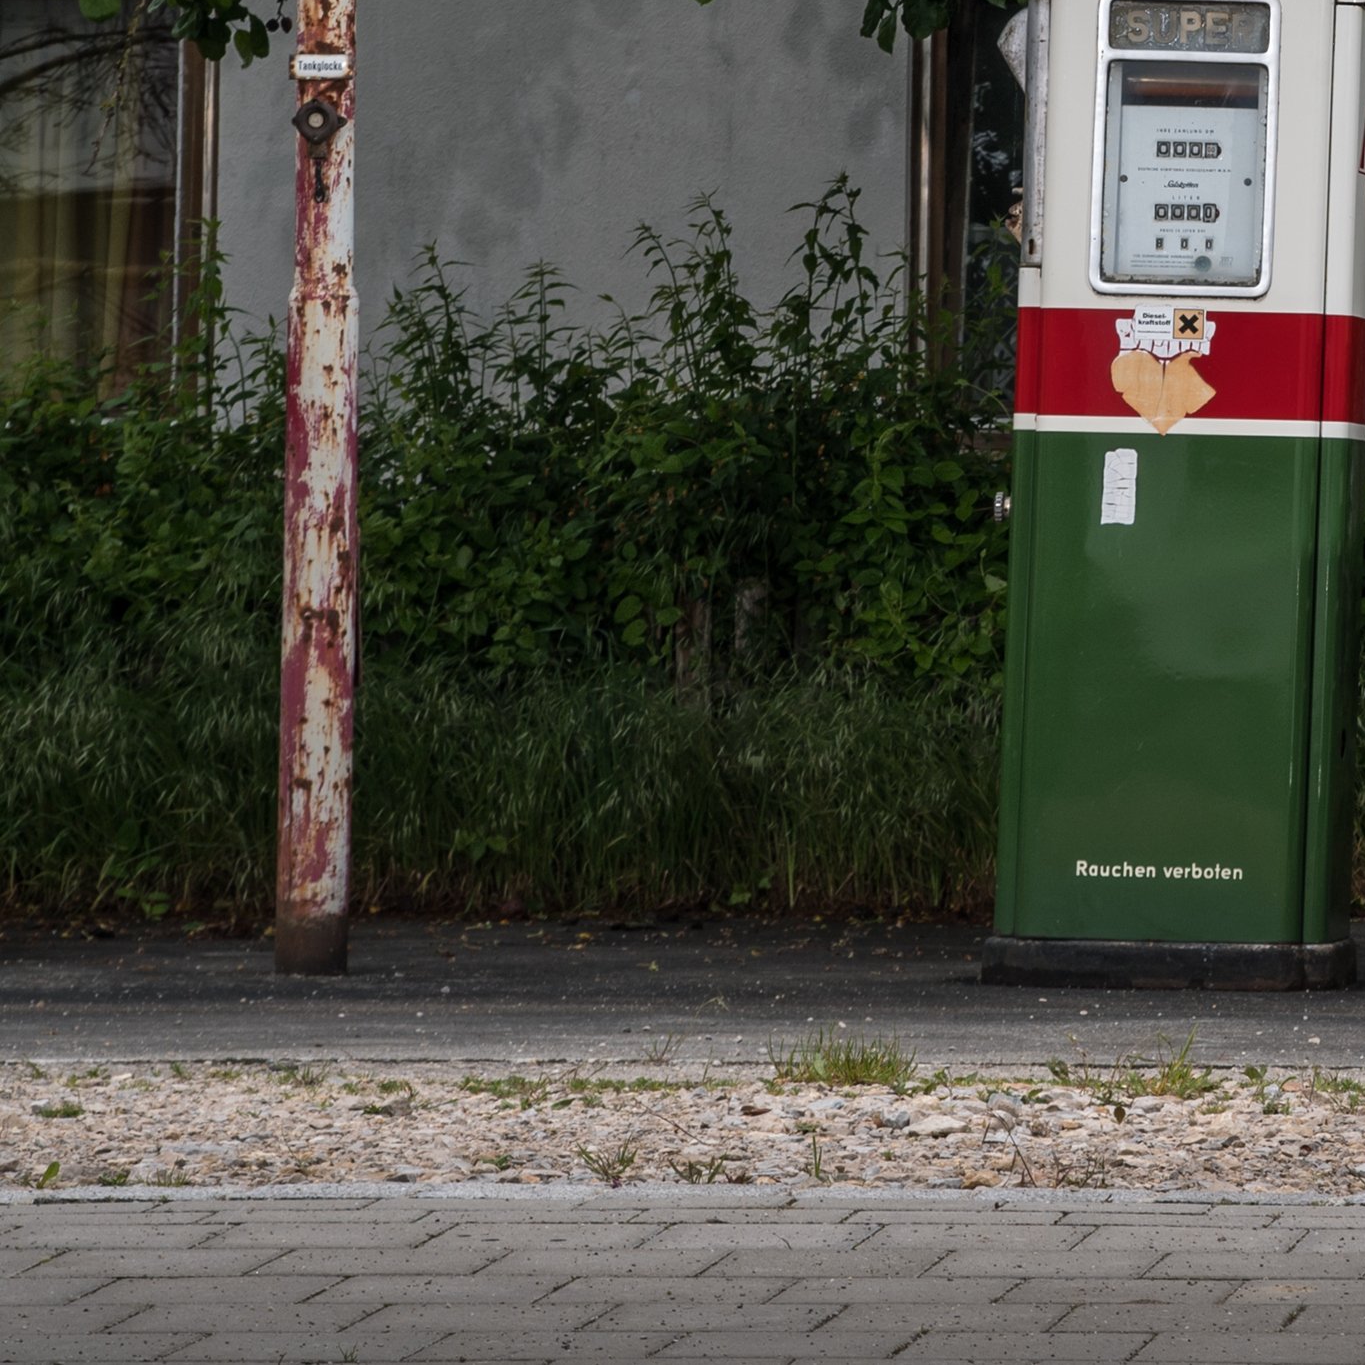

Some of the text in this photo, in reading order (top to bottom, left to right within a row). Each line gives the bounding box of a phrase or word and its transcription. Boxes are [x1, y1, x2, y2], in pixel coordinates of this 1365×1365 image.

[1126, 9, 1252, 45] SUPER
[1075, 859, 1243, 881] Rauchen verboten
